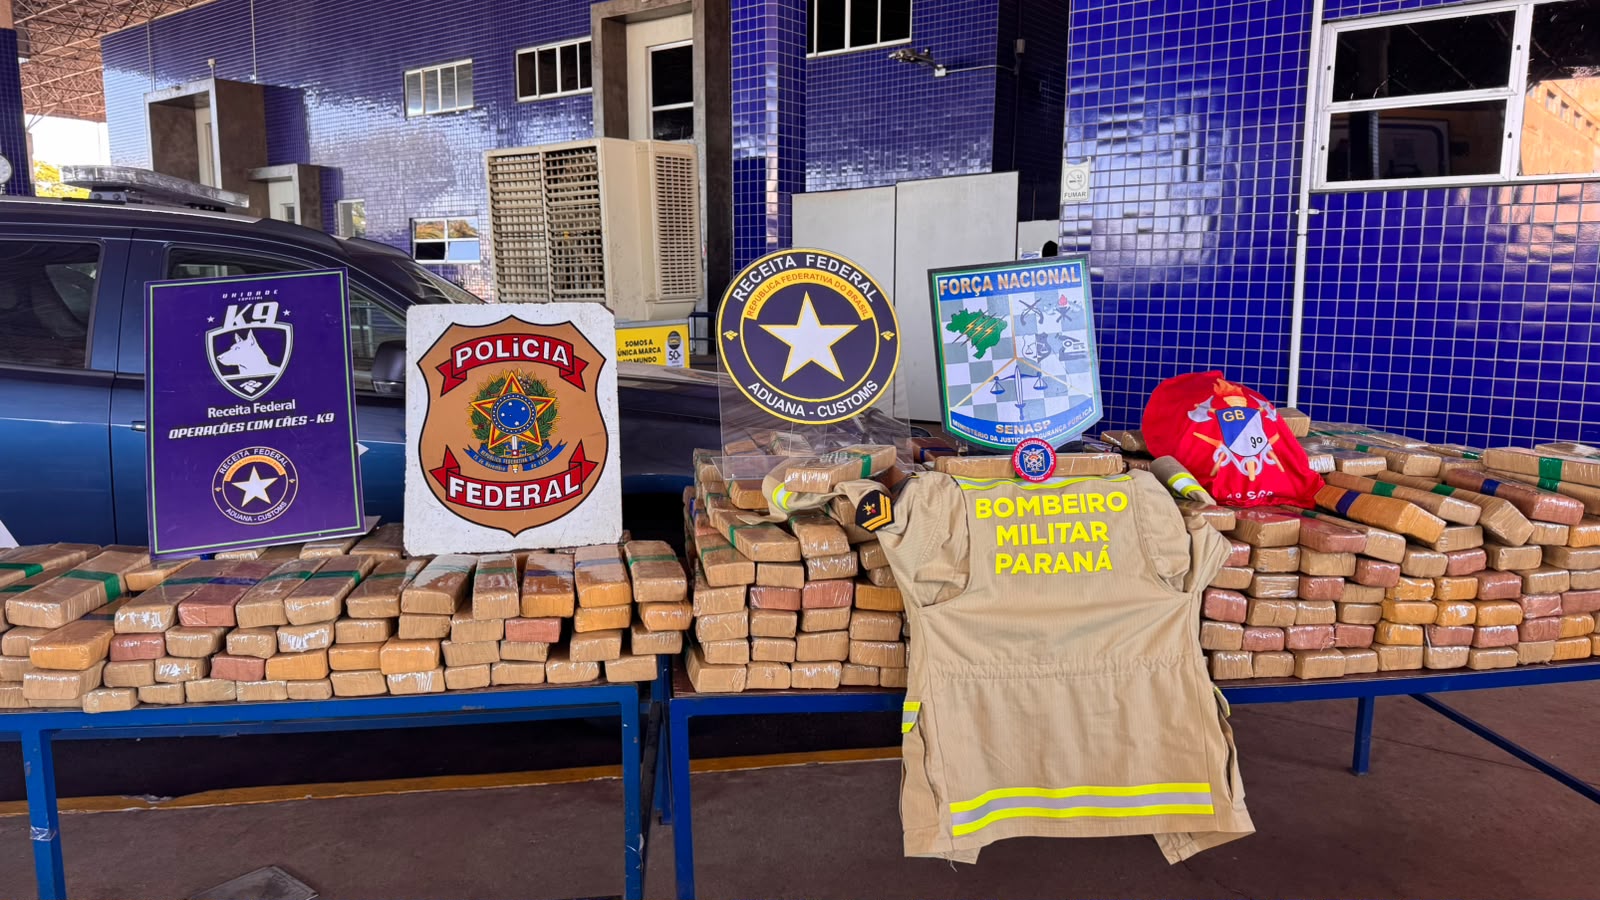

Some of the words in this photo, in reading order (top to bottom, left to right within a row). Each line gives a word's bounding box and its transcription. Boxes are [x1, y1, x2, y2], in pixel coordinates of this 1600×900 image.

[732, 255, 797, 302] RECEITA
[805, 254, 878, 302] FEDERAL
[938, 275, 994, 297] FORÇA
[997, 265, 1081, 290] NACIONAL
[746, 279, 782, 318] REPÚBLICA
[780, 272, 833, 285] FEDERATIVA
[833, 280, 847, 293] DO
[846, 286, 868, 318] BRASIL
[223, 301, 279, 329] K9
[625, 339, 648, 348] SOMOS
[638, 346, 662, 355] MARCA
[207, 404, 251, 419] Receita
[253, 398, 296, 414] Federal
[748, 381, 806, 417] ADUANA
[817, 380, 879, 418] CUSTOMS
[168, 422, 245, 440] OPERAÇÕES
[246, 419, 274, 431] COM
[275, 415, 308, 428] CÃES
[316, 412, 335, 424] K9
[995, 419, 1052, 435] SENASP
[1222, 409, 1246, 422] GB
[990, 434, 999, 442] DA
[219, 450, 250, 475] RECEITA
[253, 448, 288, 467] FEDERAL
[448, 473, 580, 508] FEDERAL
[226, 508, 253, 522] ADUANA
[257, 501, 287, 521] CUSTOMS
[975, 491, 1129, 519] BOMBEIRO
[996, 520, 1110, 547] MILITAR
[994, 544, 1113, 575] PARANÁ
